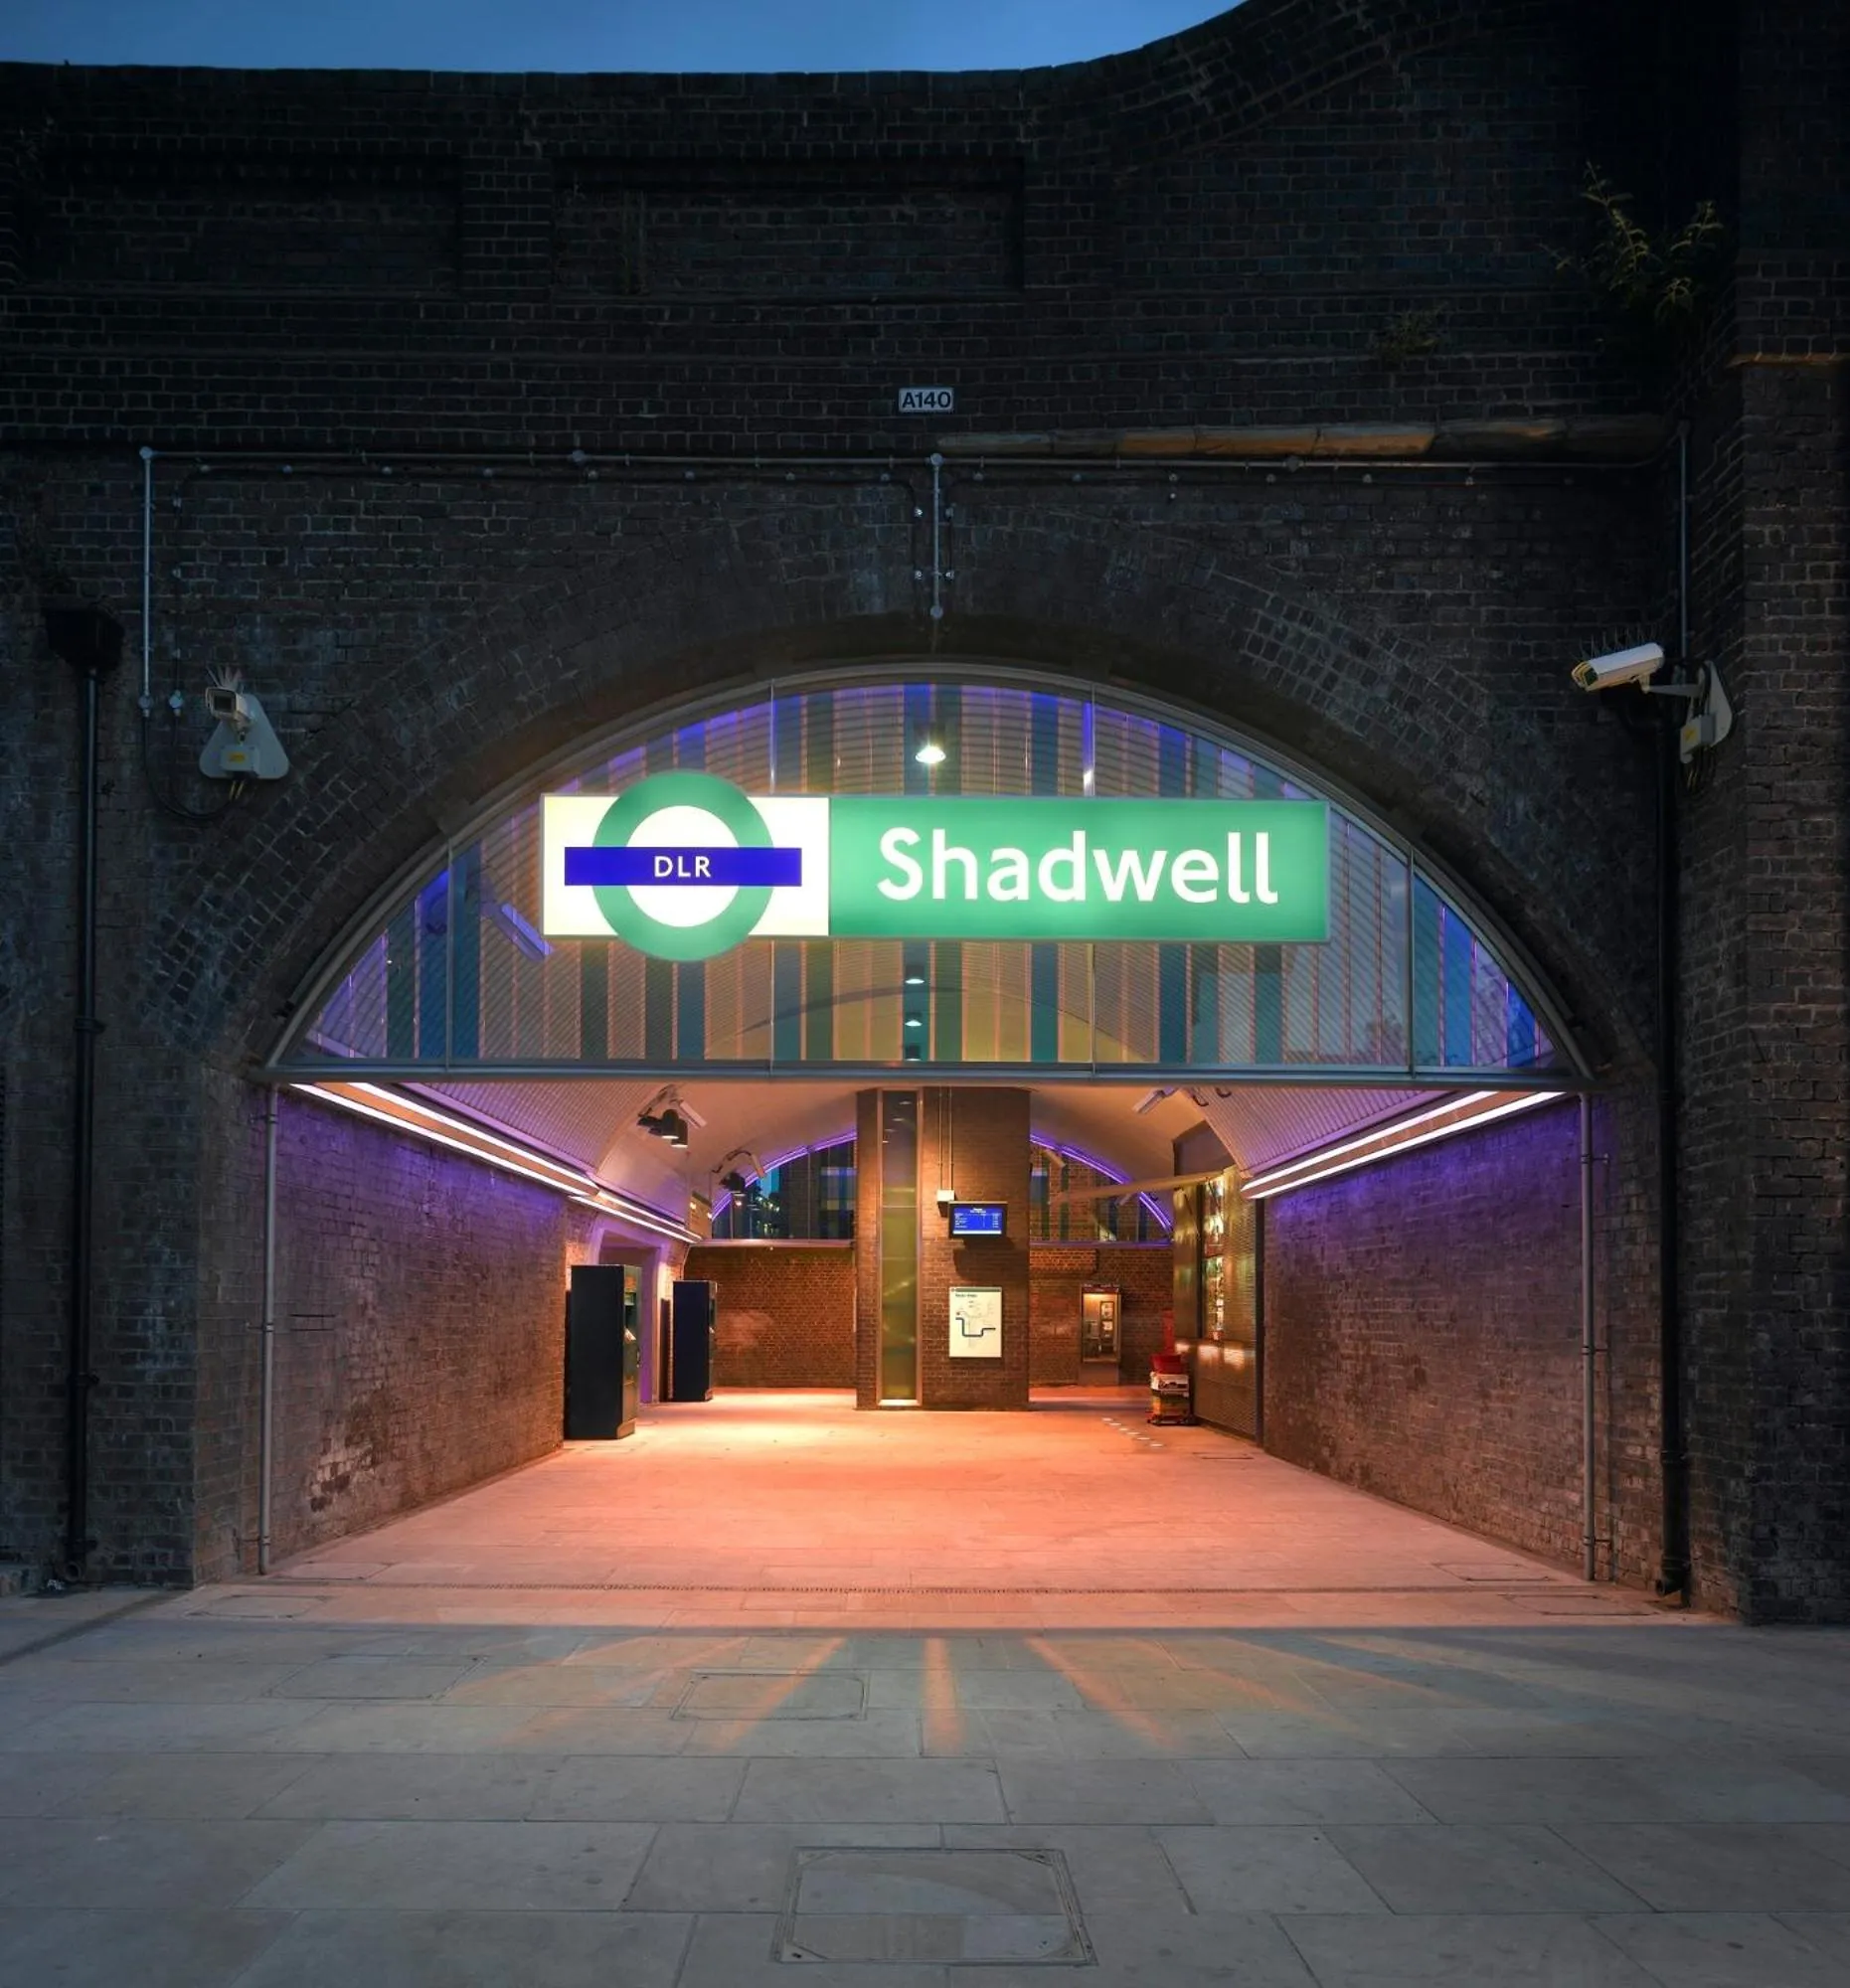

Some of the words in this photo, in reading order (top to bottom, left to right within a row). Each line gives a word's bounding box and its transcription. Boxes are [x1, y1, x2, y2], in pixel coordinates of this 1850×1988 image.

[902, 392, 951, 409] A140
[654, 855, 712, 878] DLR
[877, 827, 1278, 904] Shadwell
